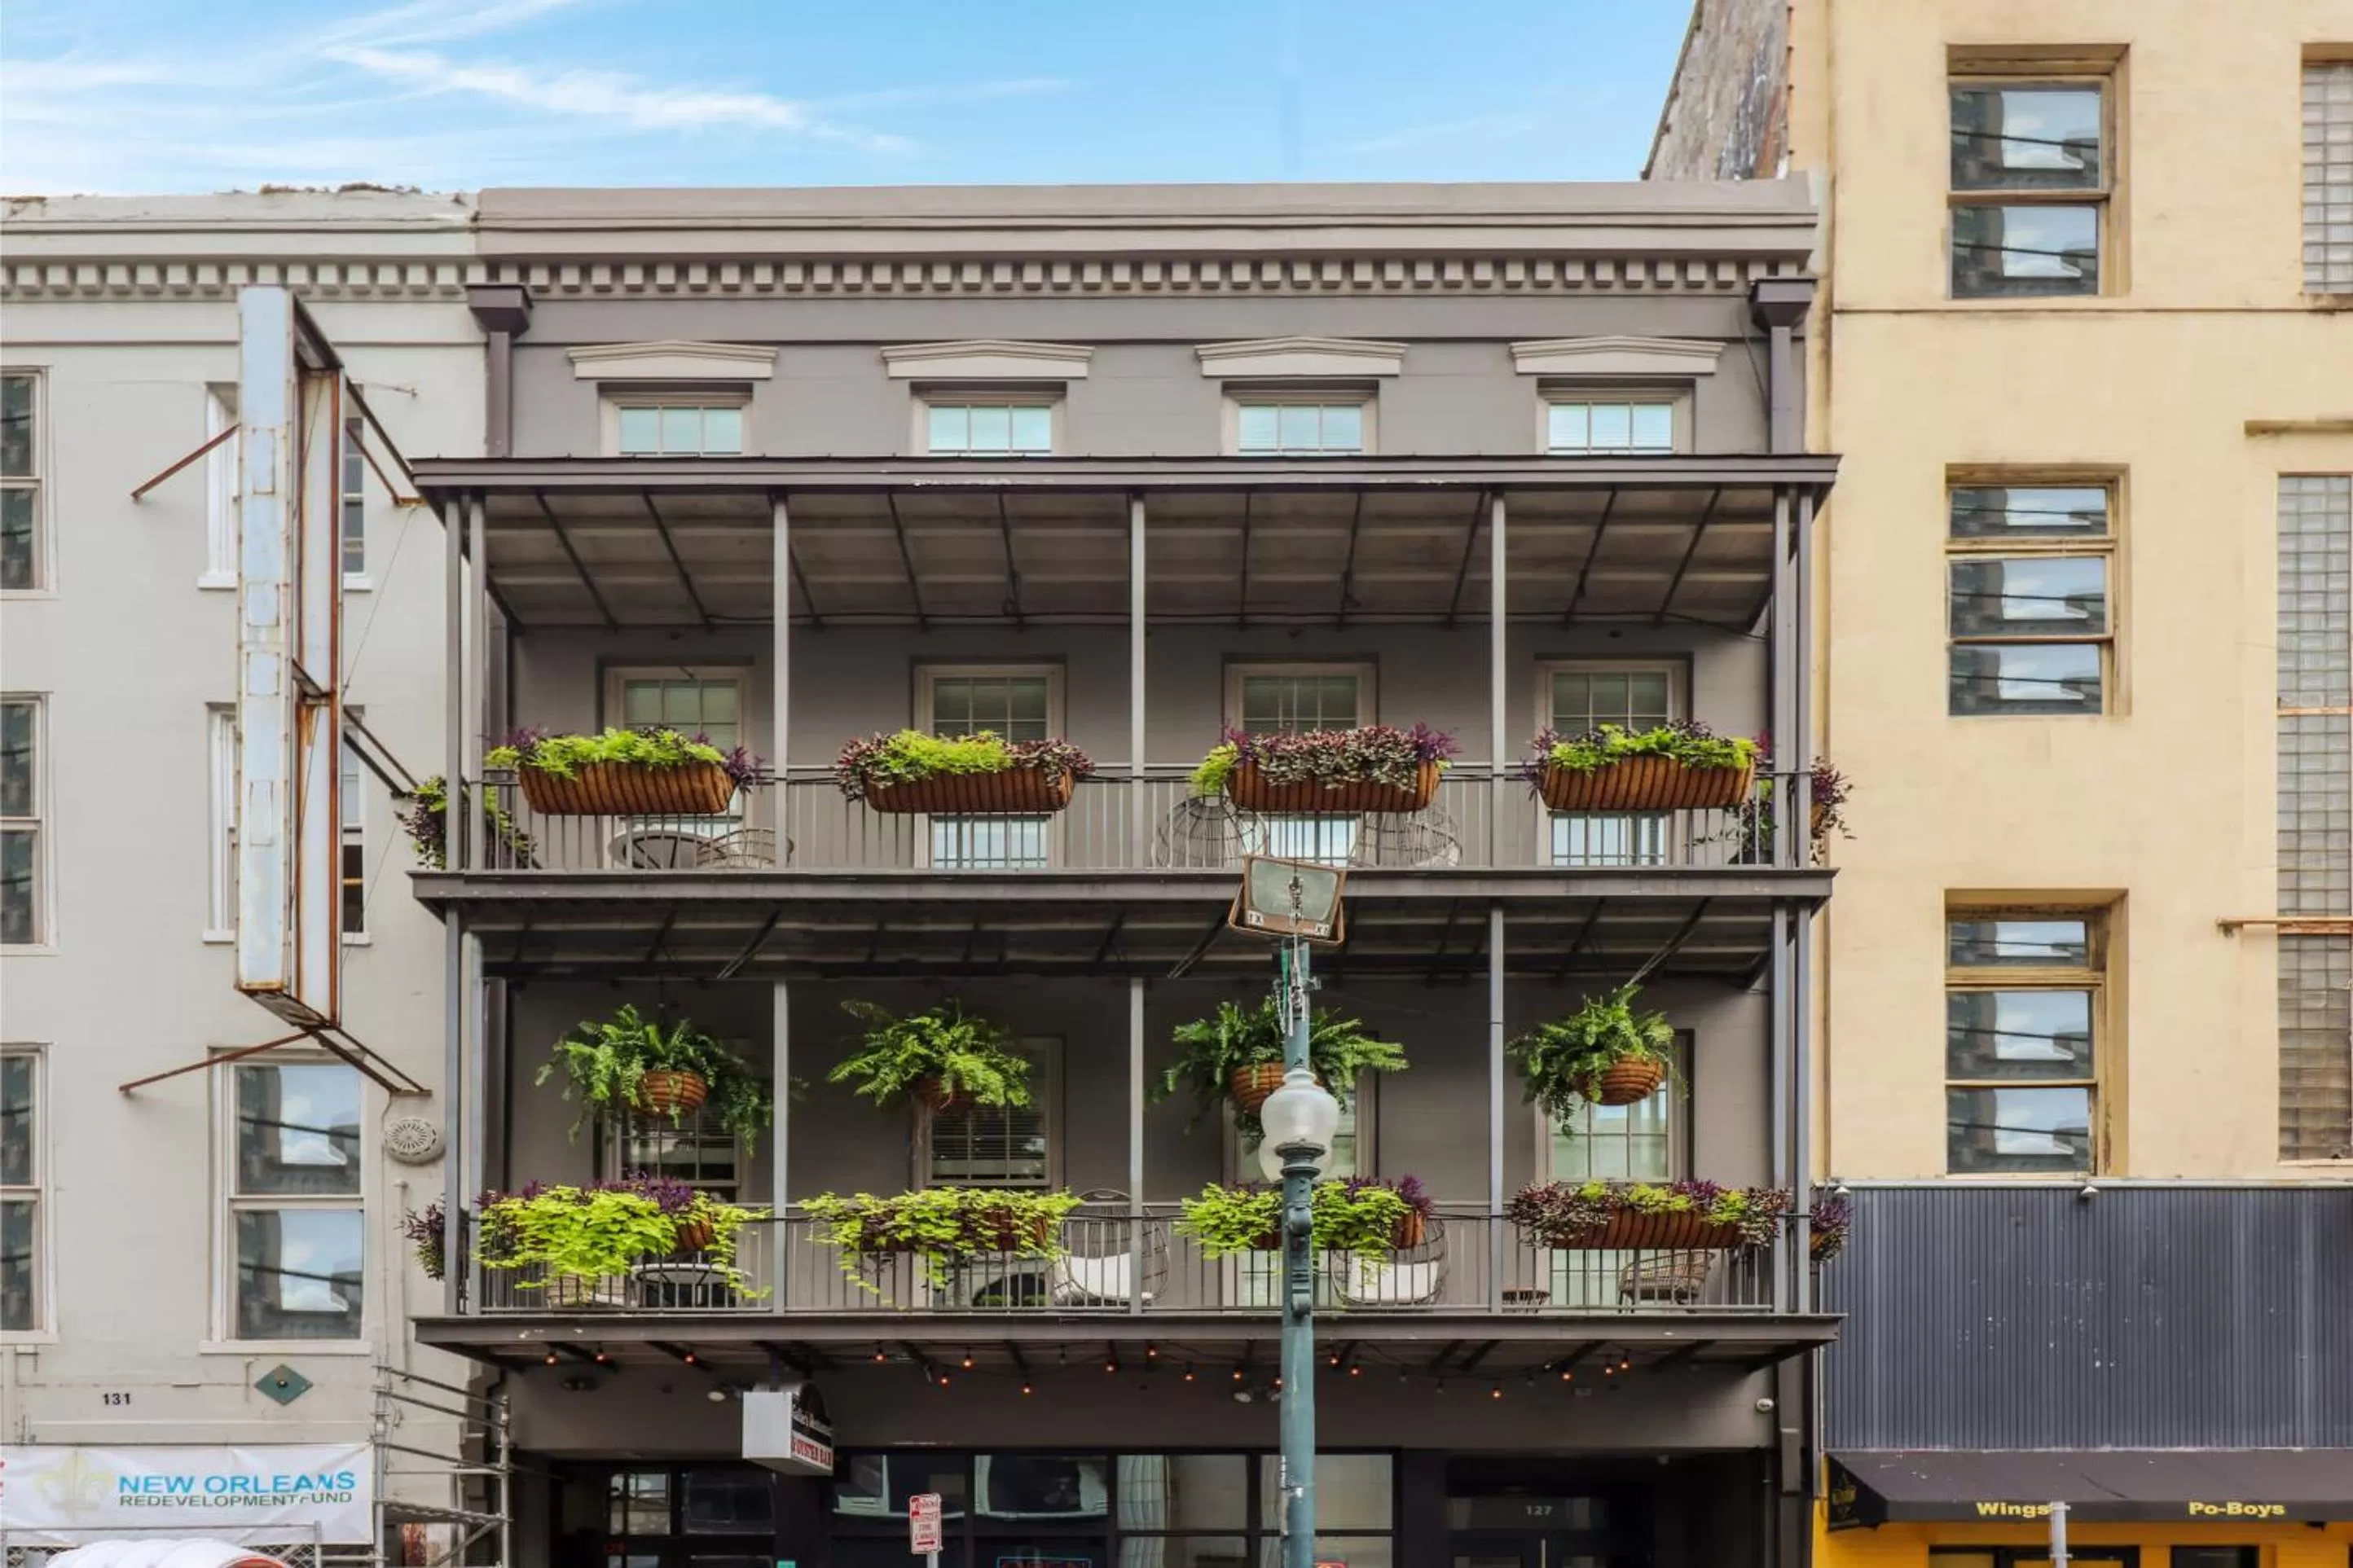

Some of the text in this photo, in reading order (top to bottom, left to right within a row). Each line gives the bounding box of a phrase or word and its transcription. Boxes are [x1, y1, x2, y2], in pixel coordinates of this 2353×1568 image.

[103, 1392, 130, 1405] 131
[119, 1470, 355, 1493] NEW ORLEANS
[120, 1494, 297, 1507] REDEVELOPMENT
[1526, 1504, 1552, 1516] 127
[1976, 1501, 2052, 1518] Wings
[2189, 1501, 2285, 1518] Po-Boys
